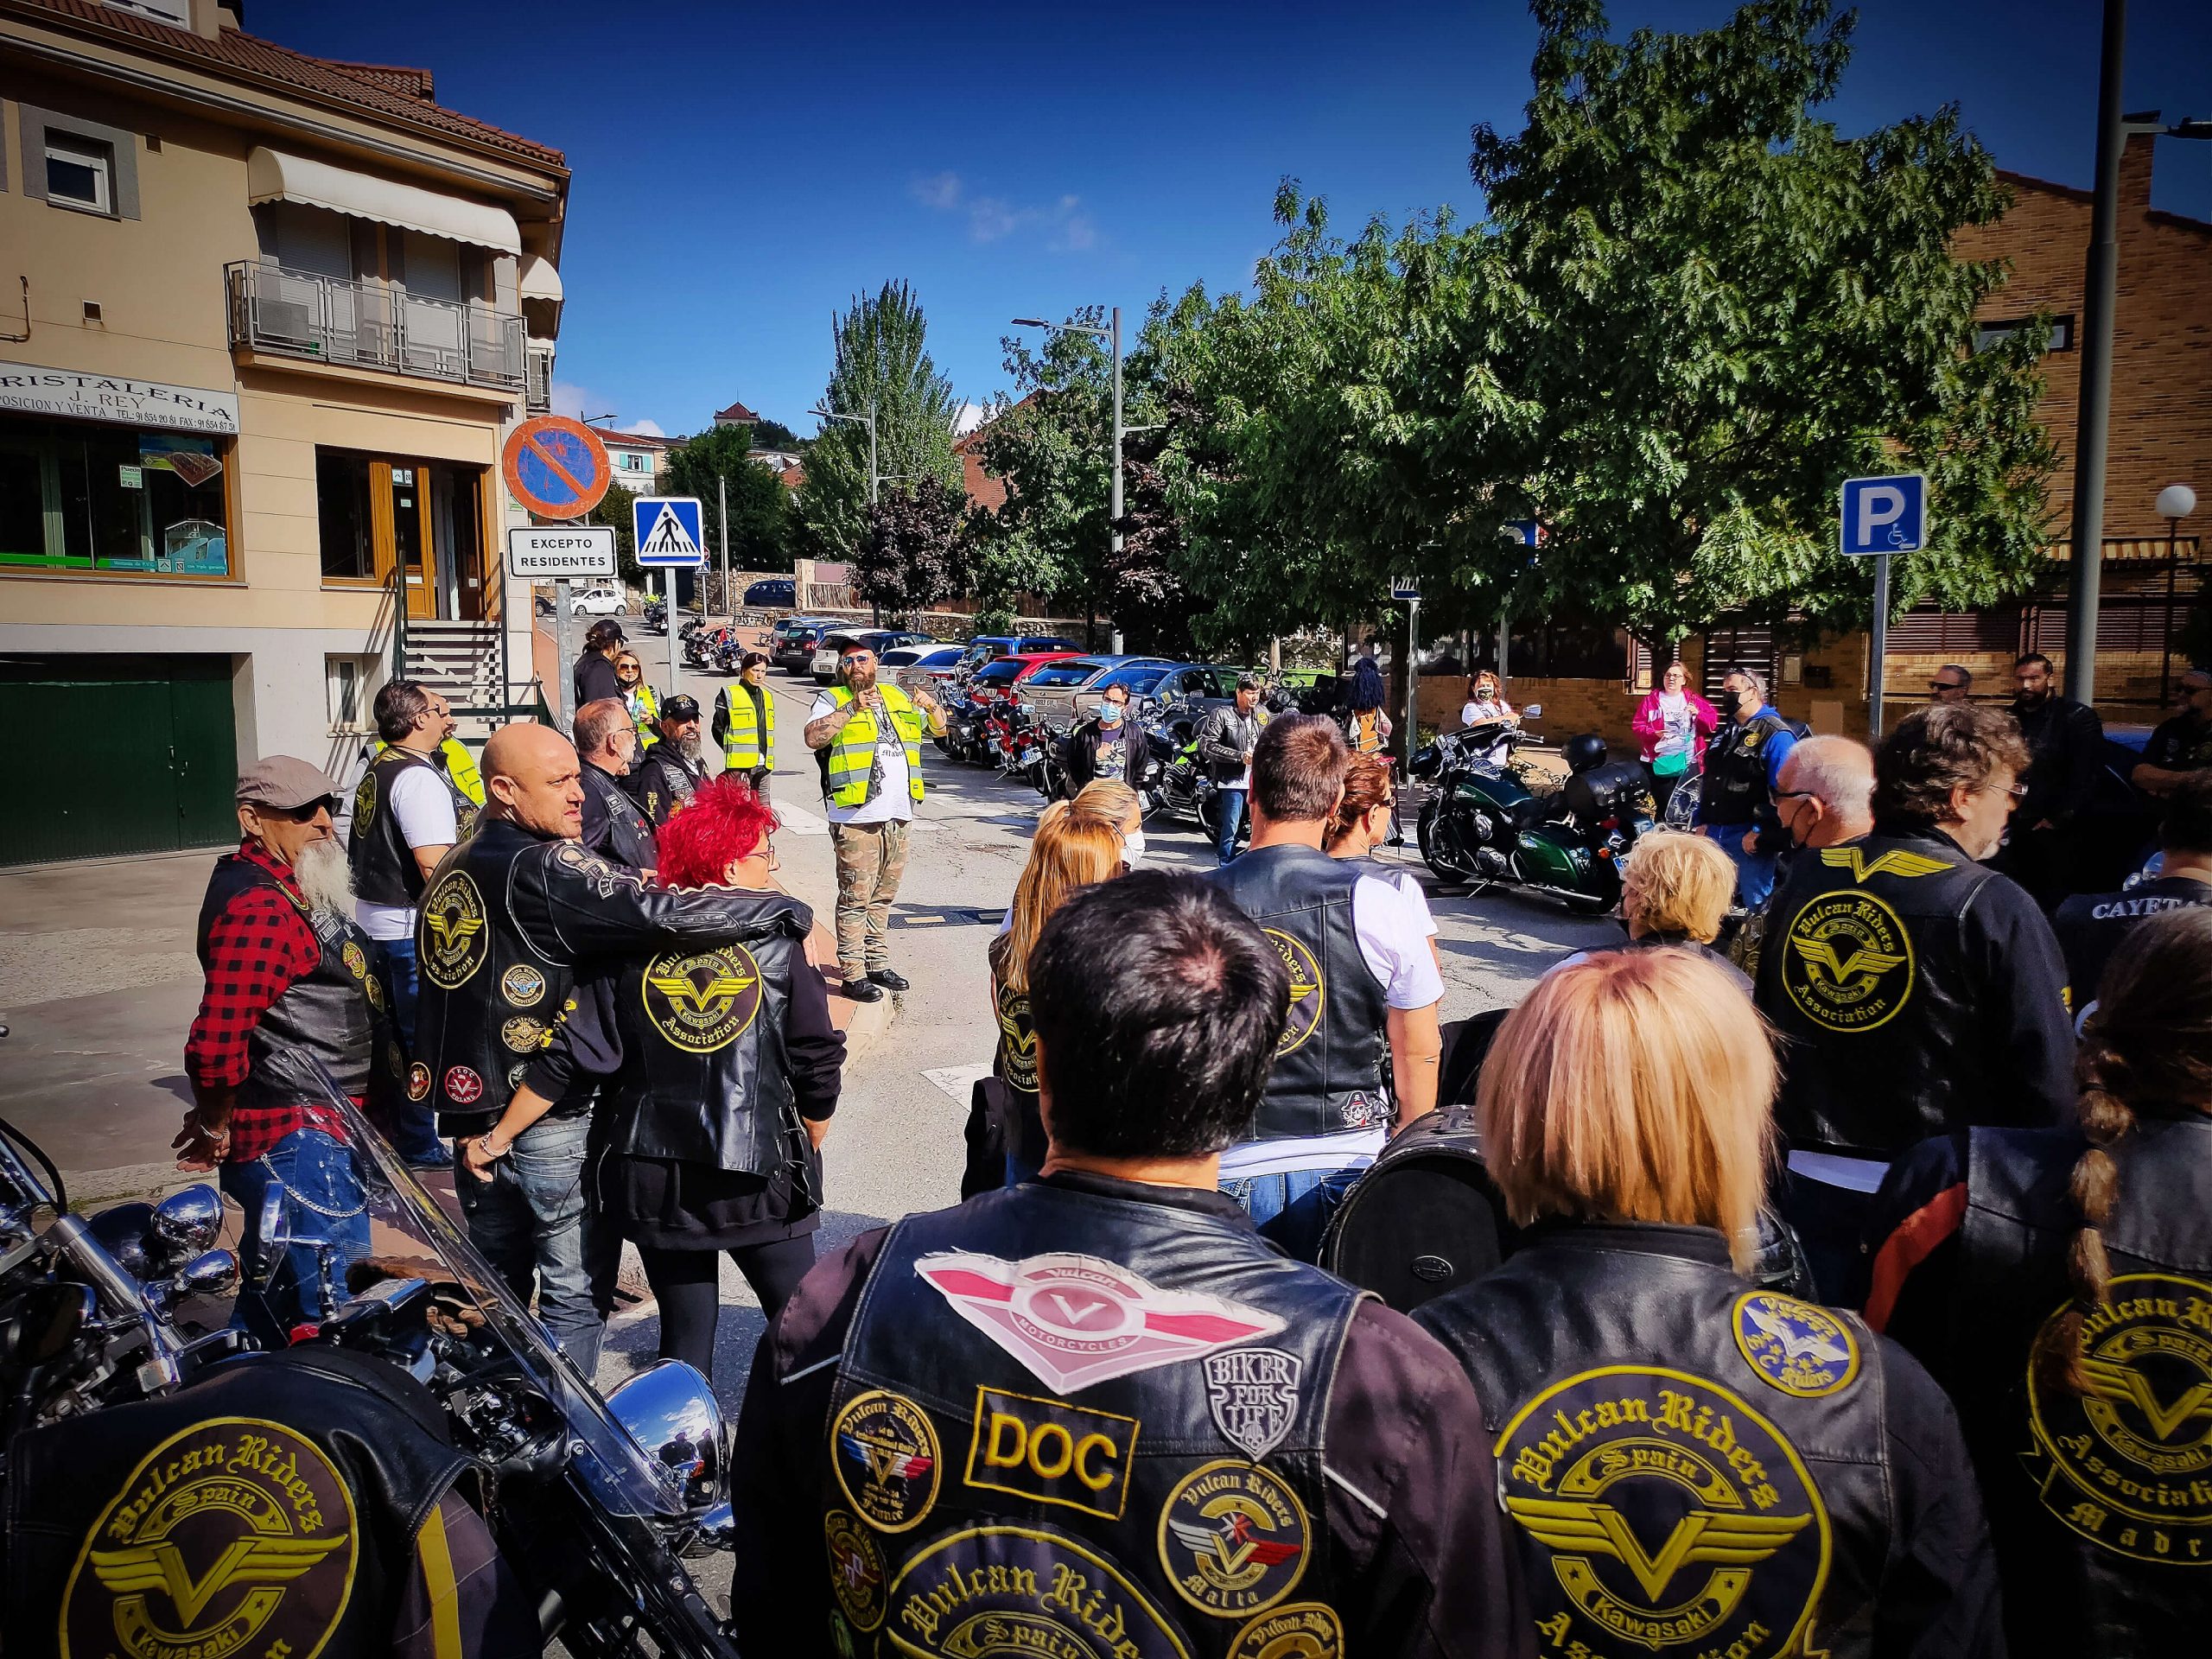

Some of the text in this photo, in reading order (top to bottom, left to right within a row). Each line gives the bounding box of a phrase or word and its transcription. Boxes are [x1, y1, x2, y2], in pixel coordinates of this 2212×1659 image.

[0, 375, 232, 422] RISTALERIA
[0, 395, 51, 410] OSICION
[55, 401, 64, 411] Y
[67, 403, 106, 416] VENTA
[99, 394, 146, 410] REY
[1858, 486, 1905, 546] P
[531, 538, 593, 549] EXCEPTO
[520, 556, 606, 567] RESIDENTES
[1798, 900, 1896, 952] Vulcan Riders
[1794, 984, 1887, 1023] Association
[662, 1016, 740, 1046] Association
[1046, 1268, 1118, 1288] Vulcan
[1019, 1319, 1127, 1351] MOTORCYCLES
[1212, 1353, 1294, 1384] BIKER
[1231, 1384, 1280, 1406] FOR
[841, 1402, 888, 1434] Vulcan
[984, 1412, 1118, 1491] DOC
[1512, 1389, 1780, 1511] Vulcan Riders
[1599, 1449, 1699, 1479] Spain
[108, 1433, 325, 1544] Vulcan Riders
[172, 1486, 257, 1517] Spain
[1180, 1473, 1294, 1528] Vulcan Riders
[2064, 1502, 2202, 1557] Madr
[1181, 1574, 1259, 1608] Malta
[901, 1562, 1037, 1646] Vulcan
[1040, 1562, 1140, 1659] Ride
[1592, 1596, 1714, 1638] Kawasaki
[137, 1625, 241, 1659] Kawasaki
